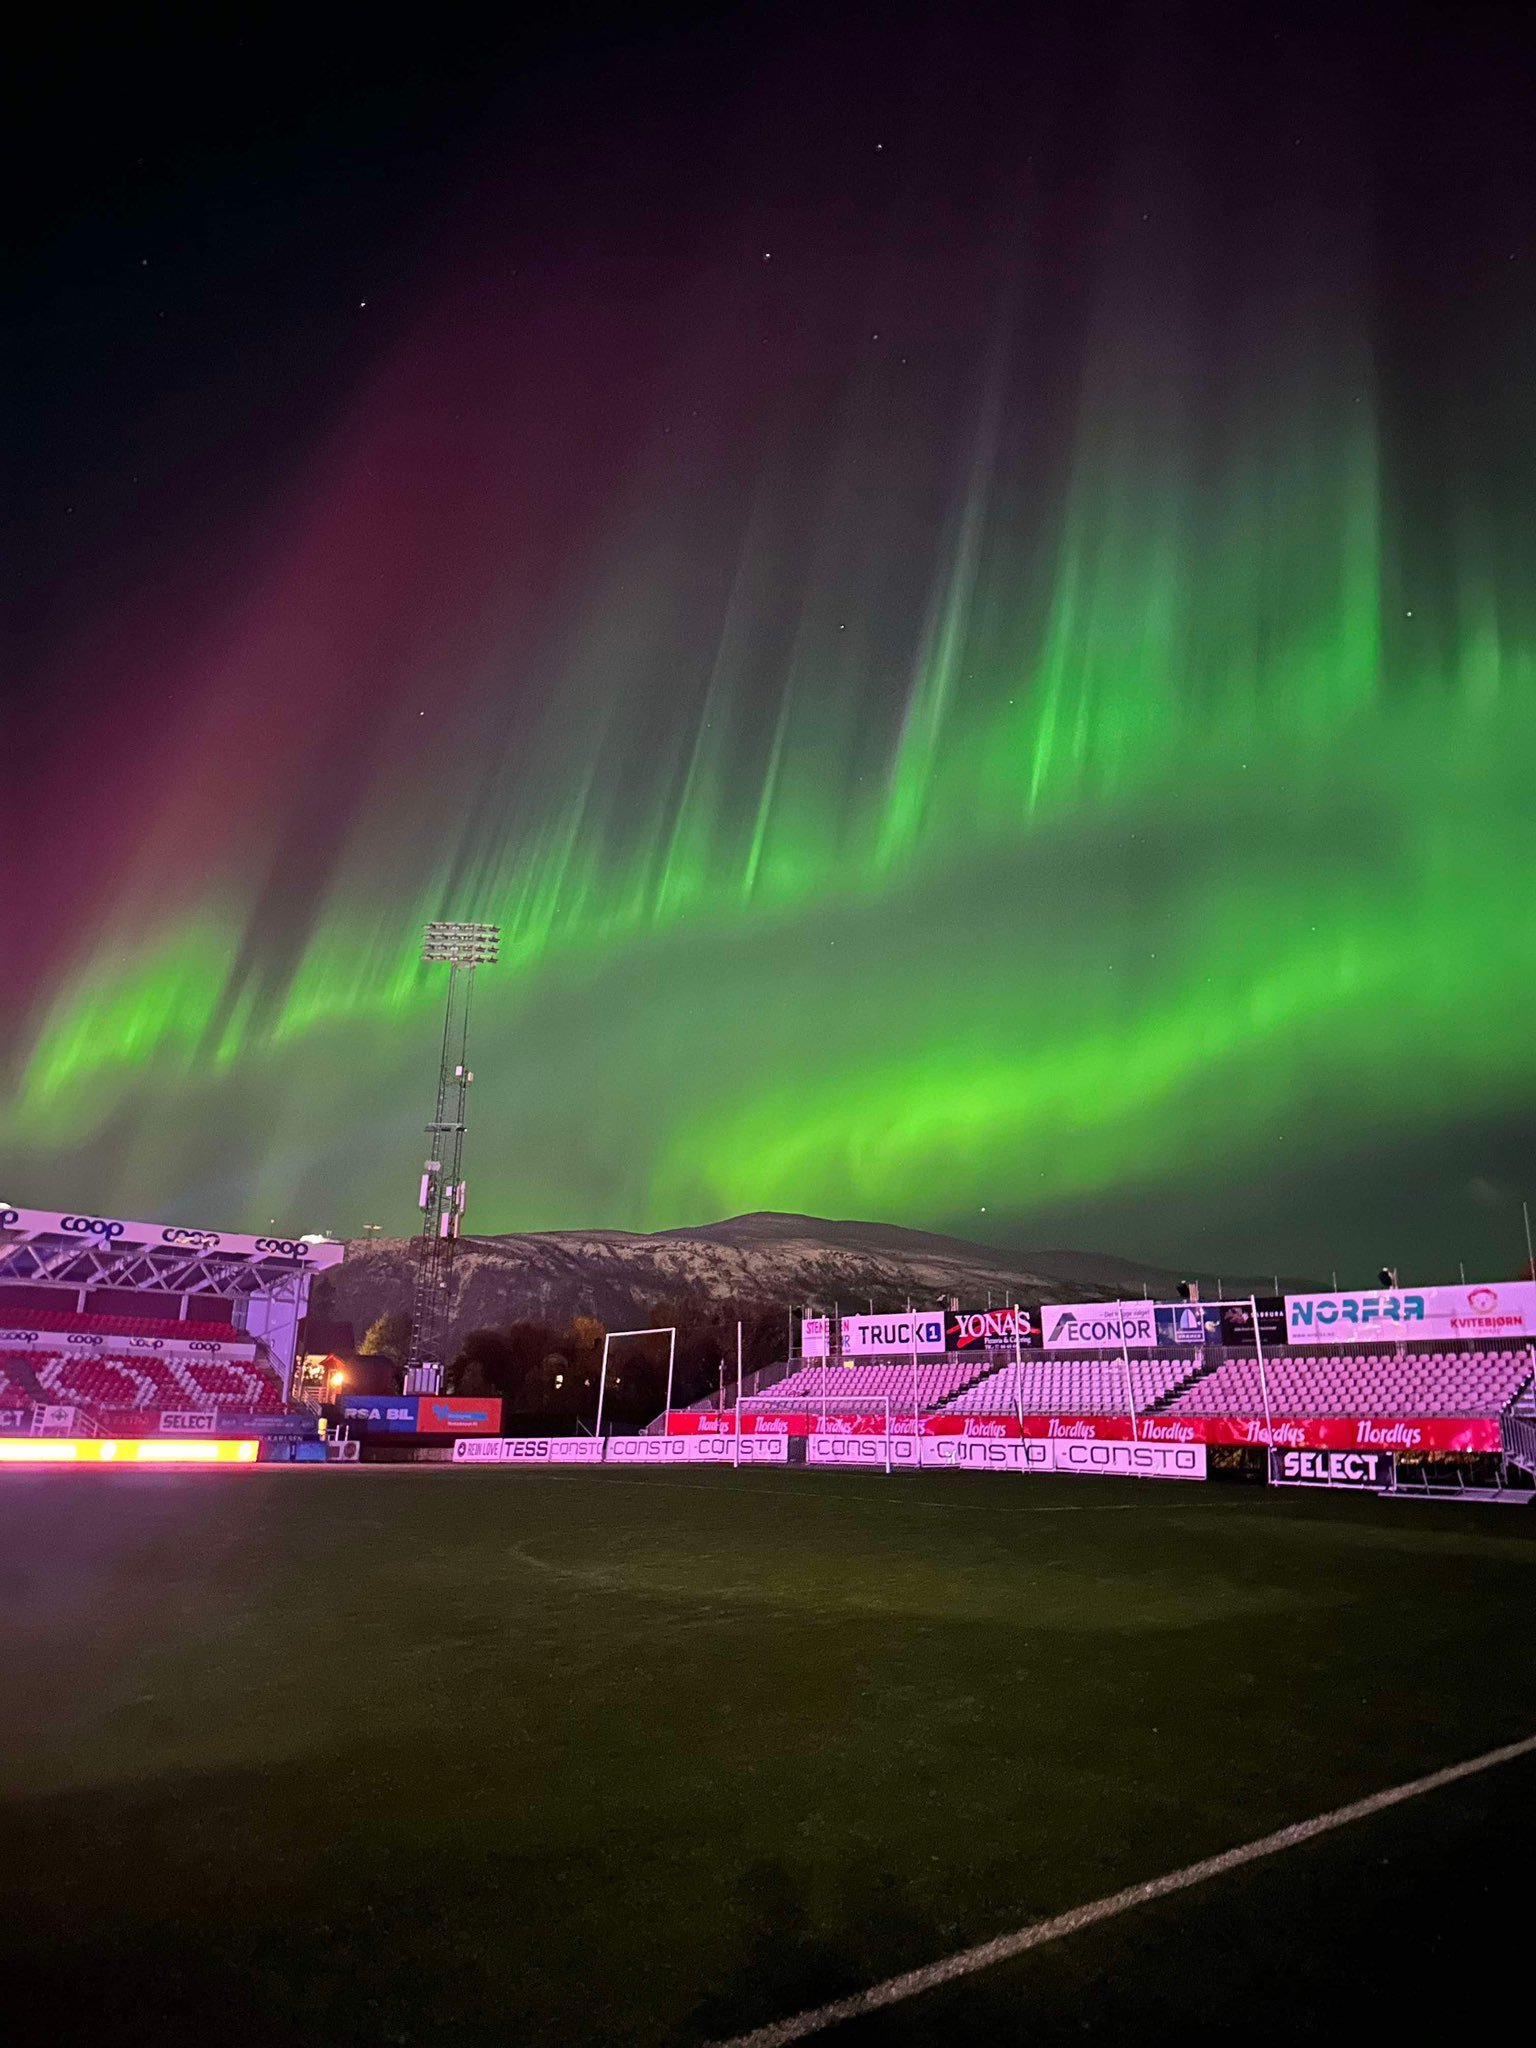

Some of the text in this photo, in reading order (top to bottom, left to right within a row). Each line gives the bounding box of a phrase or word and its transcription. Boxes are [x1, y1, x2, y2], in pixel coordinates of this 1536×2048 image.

[60, 1216, 124, 1241] coop
[254, 1238, 307, 1260] coop
[1291, 1295, 1425, 1327] NORFRA
[1450, 1316, 1522, 1328] KVITEBJØRN
[954, 1311, 1031, 1338] YONAS
[1067, 1320, 1151, 1342] ECONOR
[67, 1333, 104, 1346] coop
[188, 1340, 222, 1353] coop
[162, 1415, 214, 1430] SELECT
[344, 1408, 415, 1421] RSA BIL
[963, 1417, 1007, 1437] Nordlys
[1047, 1418, 1096, 1440] Nordlys
[1141, 1419, 1195, 1442] Nordlys
[1356, 1420, 1422, 1448] Nordlys
[504, 1441, 549, 1457] TESS
[1283, 1451, 1378, 1481] SELECT
